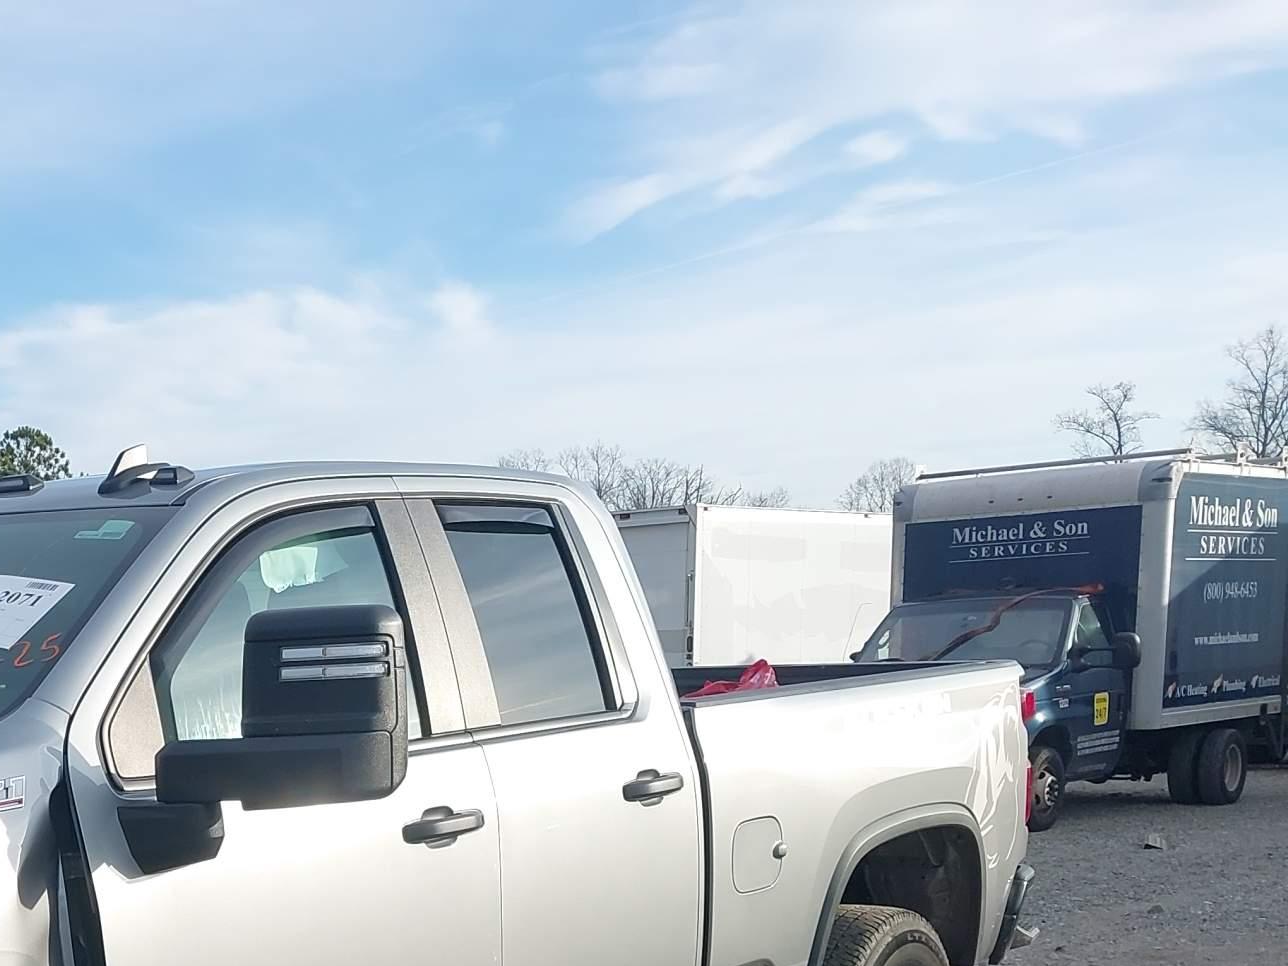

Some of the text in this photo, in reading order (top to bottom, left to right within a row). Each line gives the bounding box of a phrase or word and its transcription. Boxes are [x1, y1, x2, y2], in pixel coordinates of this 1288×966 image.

[1190, 495, 1278, 528] Michael & Son
[952, 519, 1088, 544] Michael & Son
[969, 541, 1068, 558] SERVICES
[1200, 535, 1265, 555] SERVICES
[1203, 582, 1224, 603] (800)
